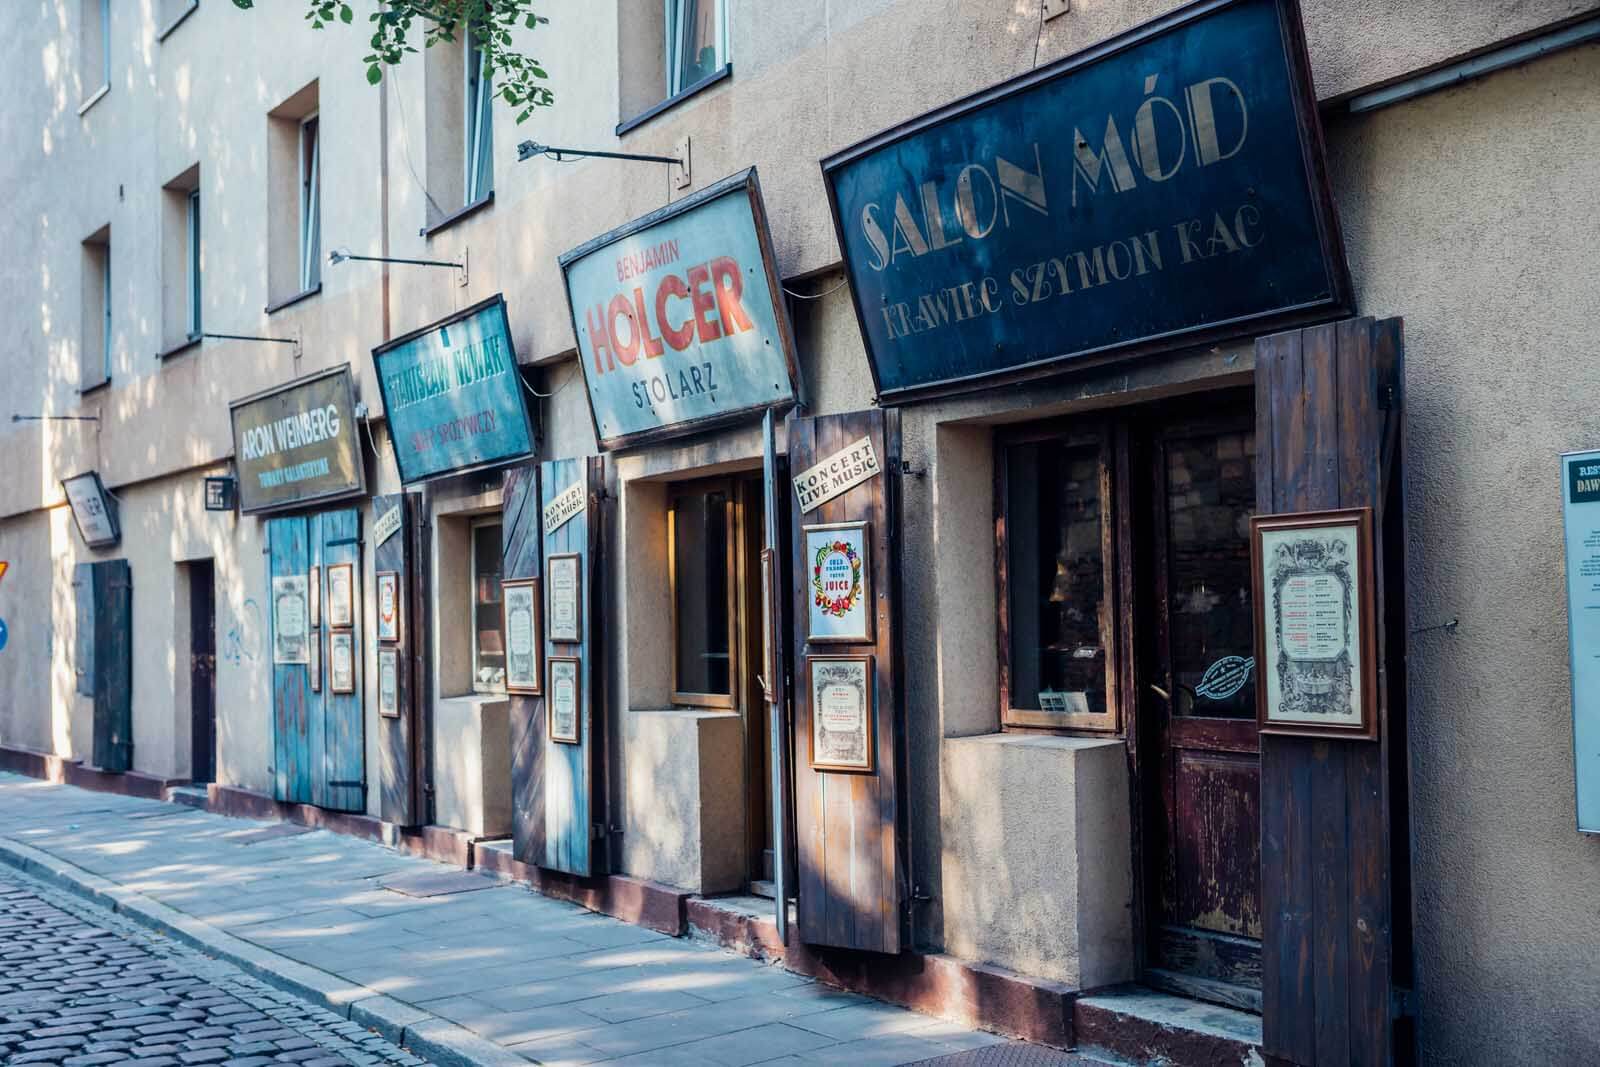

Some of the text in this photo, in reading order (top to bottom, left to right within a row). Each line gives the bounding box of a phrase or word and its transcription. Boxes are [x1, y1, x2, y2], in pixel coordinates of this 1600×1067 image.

[862, 74, 1249, 272] SALON MÓD
[616, 238, 680, 283] BENJAMIN
[879, 203, 1266, 341] KRAWIEC SZYMON KAC
[586, 255, 754, 375] HOLCER
[632, 361, 718, 409] STOLARZ
[242, 404, 340, 461] ARON WEINBERG
[796, 444, 870, 494] KONCERT
[800, 457, 876, 507] LIVE MUSIC
[1577, 478, 1600, 493] DAW
[545, 487, 582, 520] KONCERT
[546, 496, 584, 530] LIVE MUSIC
[825, 580, 849, 591] JUICE
